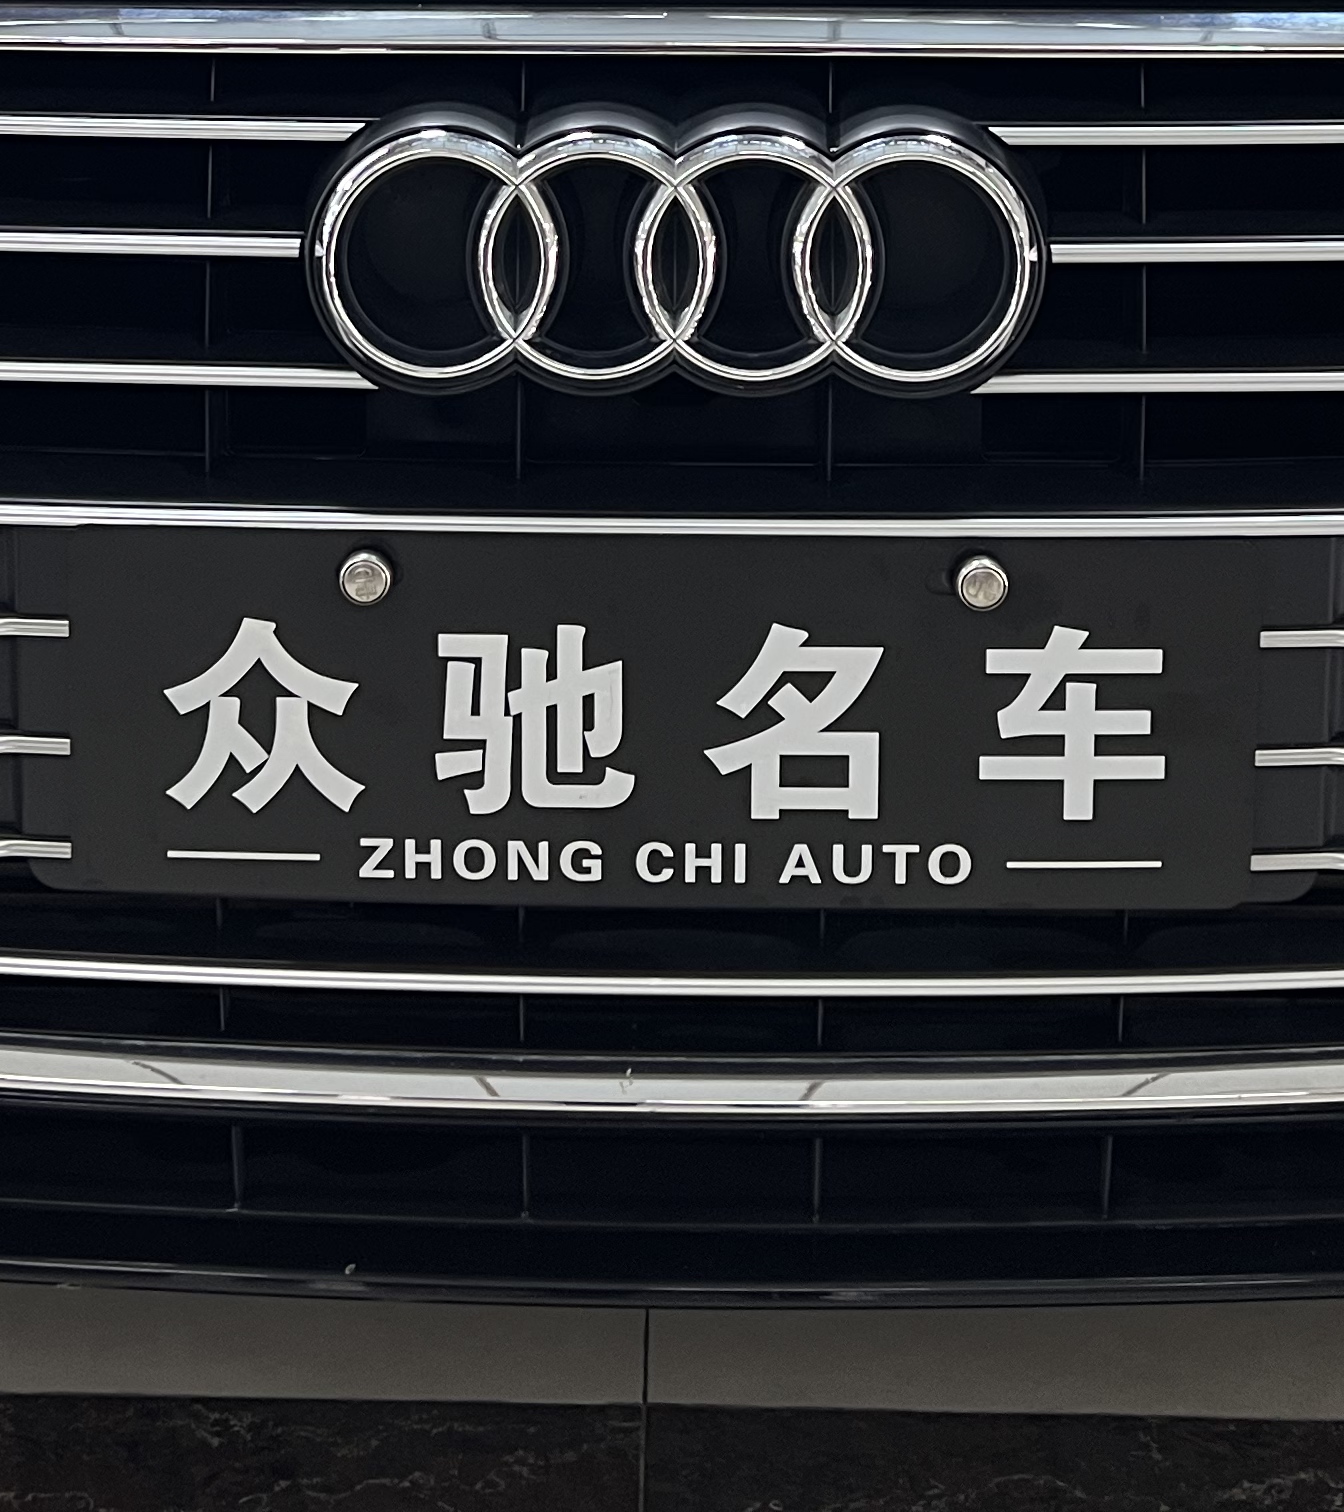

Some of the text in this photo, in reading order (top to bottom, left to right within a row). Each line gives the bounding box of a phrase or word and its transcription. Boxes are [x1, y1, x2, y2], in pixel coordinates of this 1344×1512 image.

[164, 616, 1166, 822] 众驰名车
[358, 837, 973, 886] ZHONG CHI AUTO
